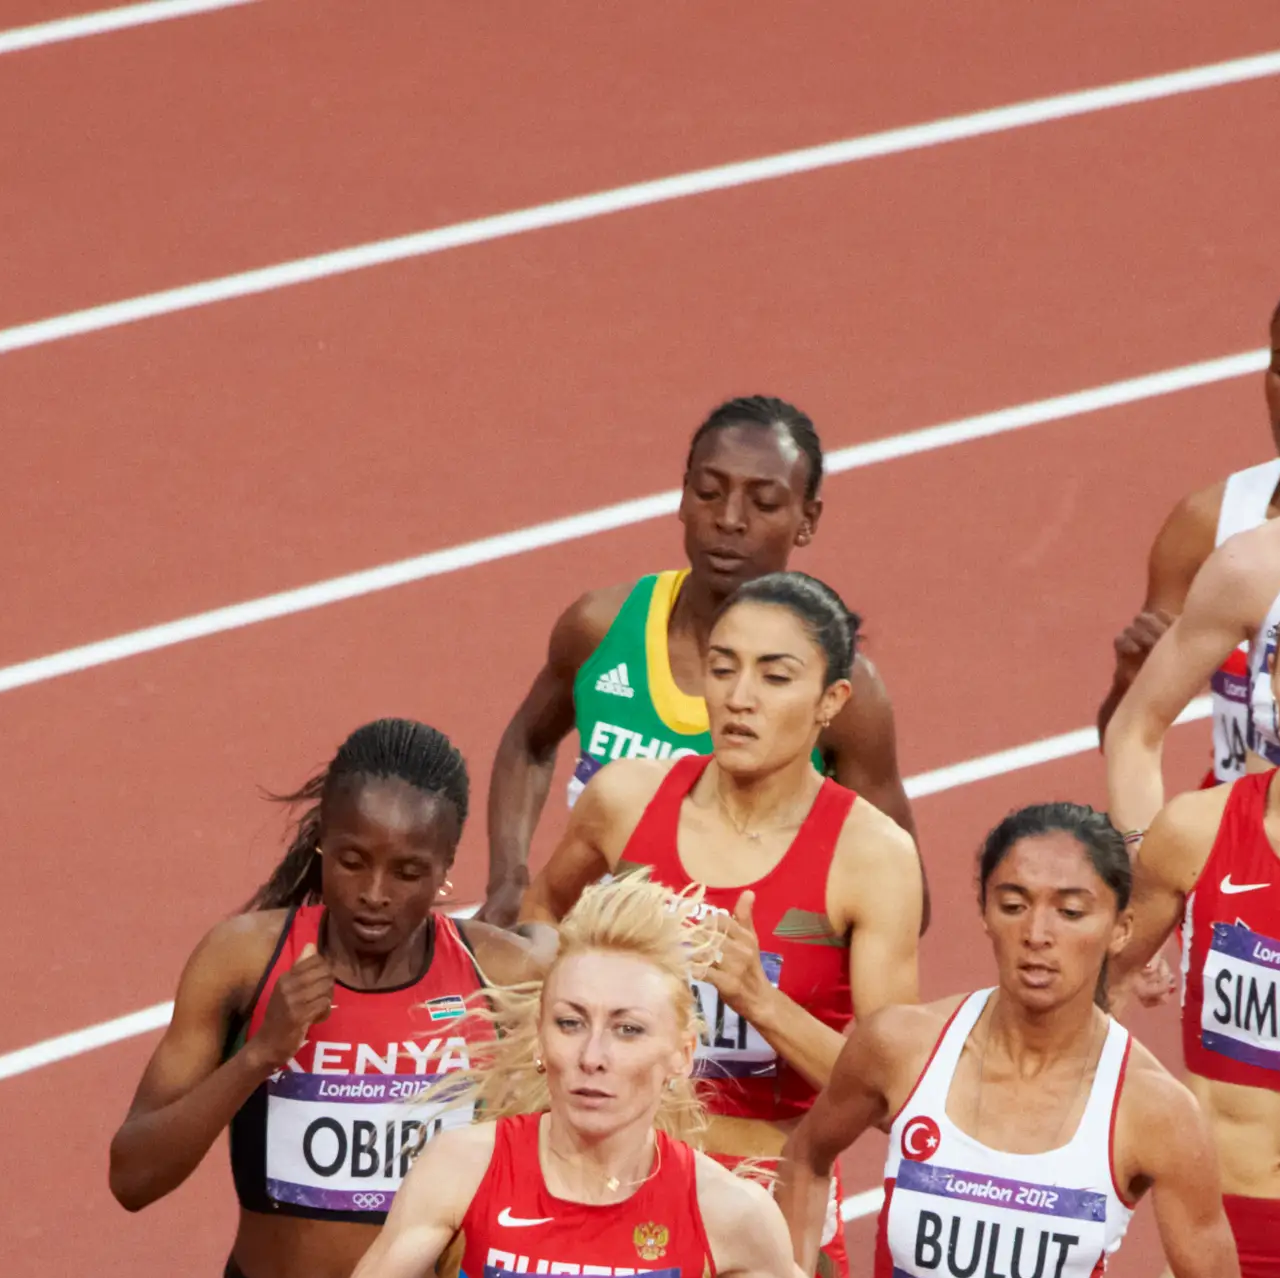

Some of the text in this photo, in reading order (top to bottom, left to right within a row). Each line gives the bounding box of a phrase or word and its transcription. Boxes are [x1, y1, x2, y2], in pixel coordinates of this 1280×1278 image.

[588, 720, 700, 760] ETHI
[319, 1079, 386, 1098] London
[302, 1116, 442, 1178] OBIR
[945, 1176, 1059, 1209] London 2012
